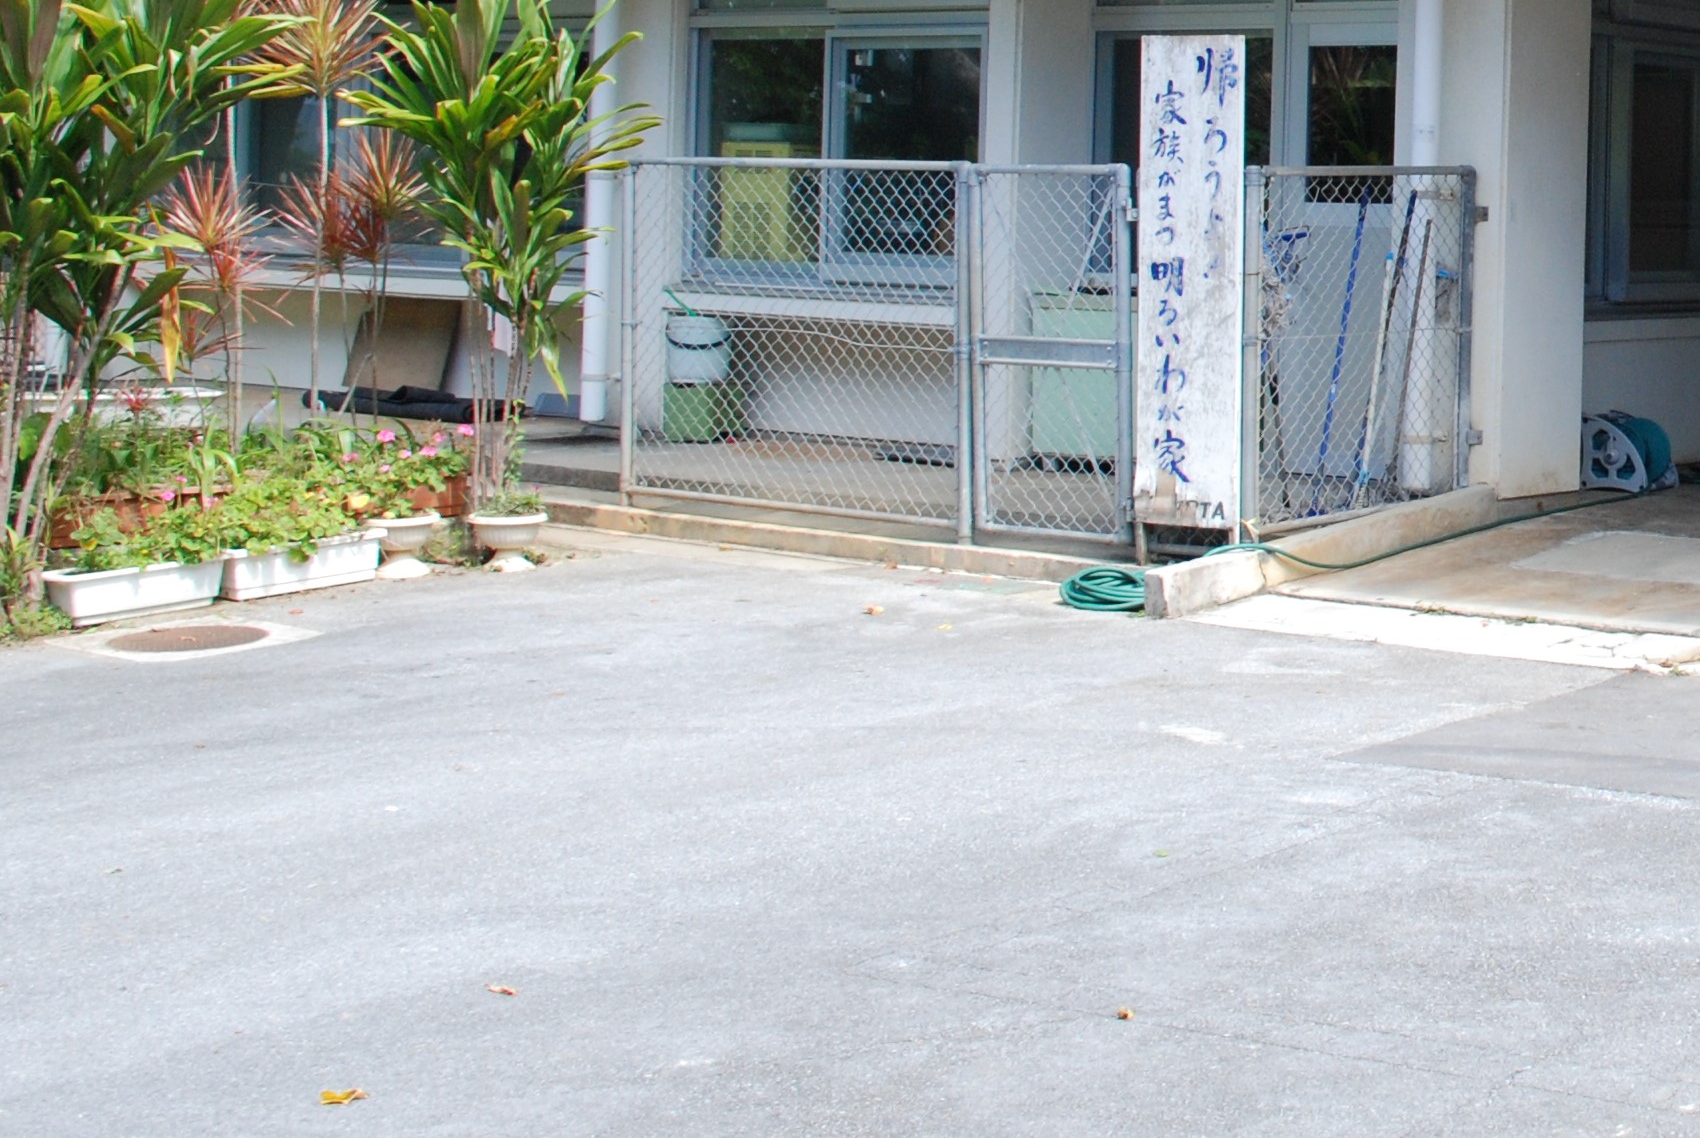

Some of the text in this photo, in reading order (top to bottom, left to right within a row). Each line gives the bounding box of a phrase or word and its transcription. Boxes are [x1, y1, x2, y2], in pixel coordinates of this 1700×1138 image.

[1150, 79, 1190, 484] 家族がまつ明るいわが家
